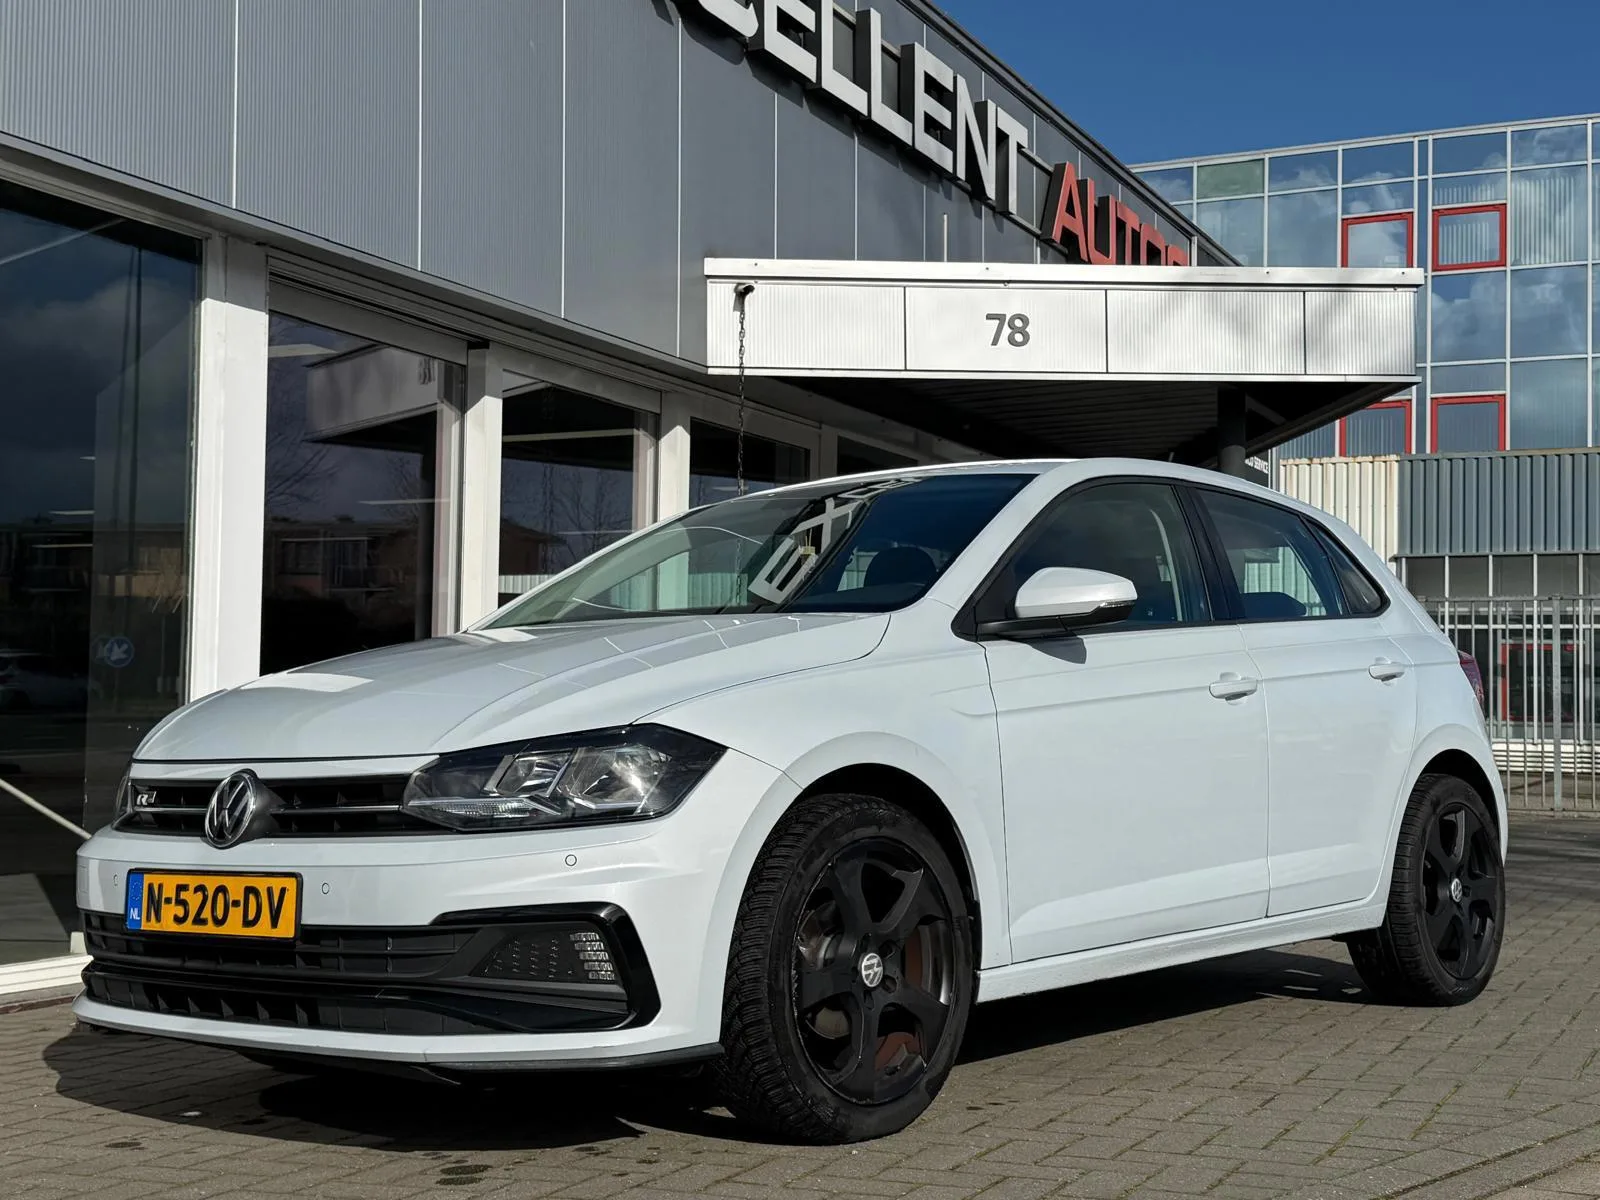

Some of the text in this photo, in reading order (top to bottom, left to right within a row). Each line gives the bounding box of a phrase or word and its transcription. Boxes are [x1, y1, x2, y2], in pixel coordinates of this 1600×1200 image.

[697, 0, 1029, 217] ELLENT
[985, 312, 1031, 347] 78
[129, 907, 141, 921] NL
[146, 883, 287, 929] N-520-DV
